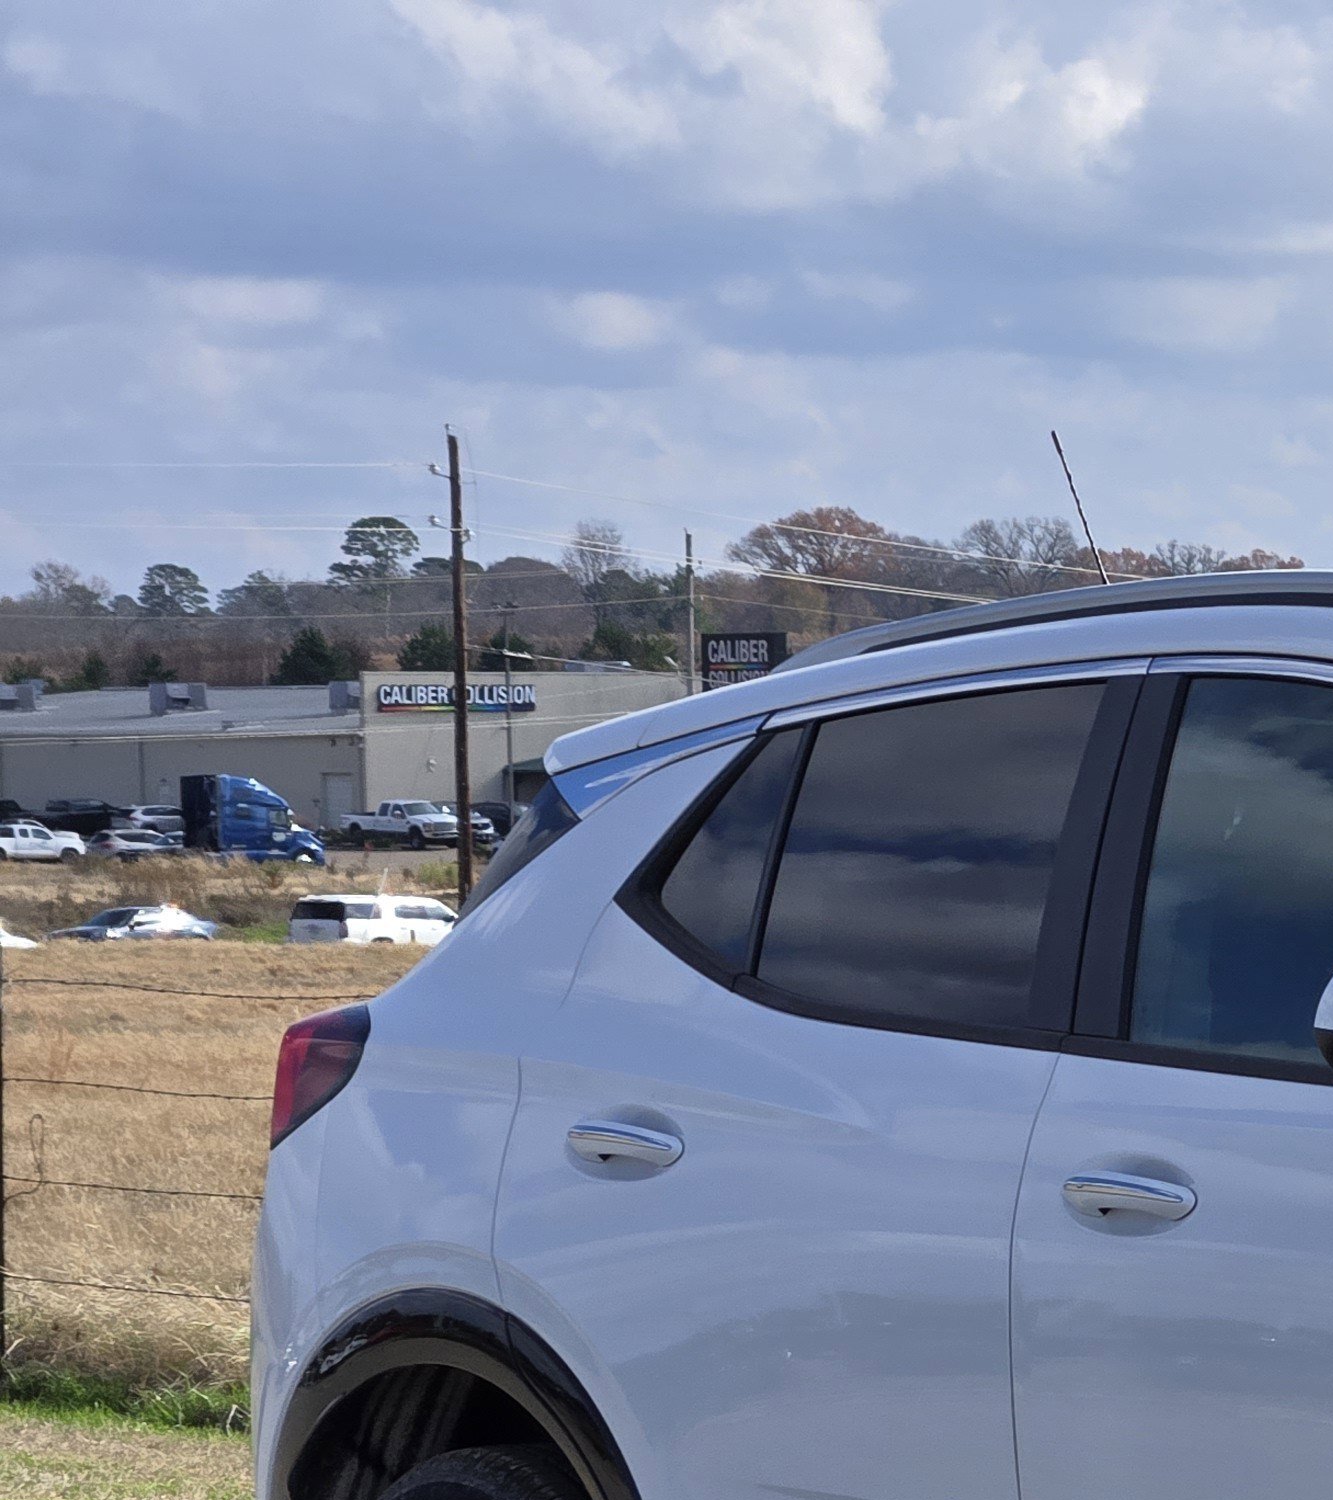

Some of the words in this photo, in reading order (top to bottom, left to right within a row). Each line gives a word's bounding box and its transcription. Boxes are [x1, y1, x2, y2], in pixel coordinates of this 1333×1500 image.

[708, 640, 768, 662] CALIBER
[379, 686, 449, 704] CALIBER
[452, 686, 535, 704] OLLISION
